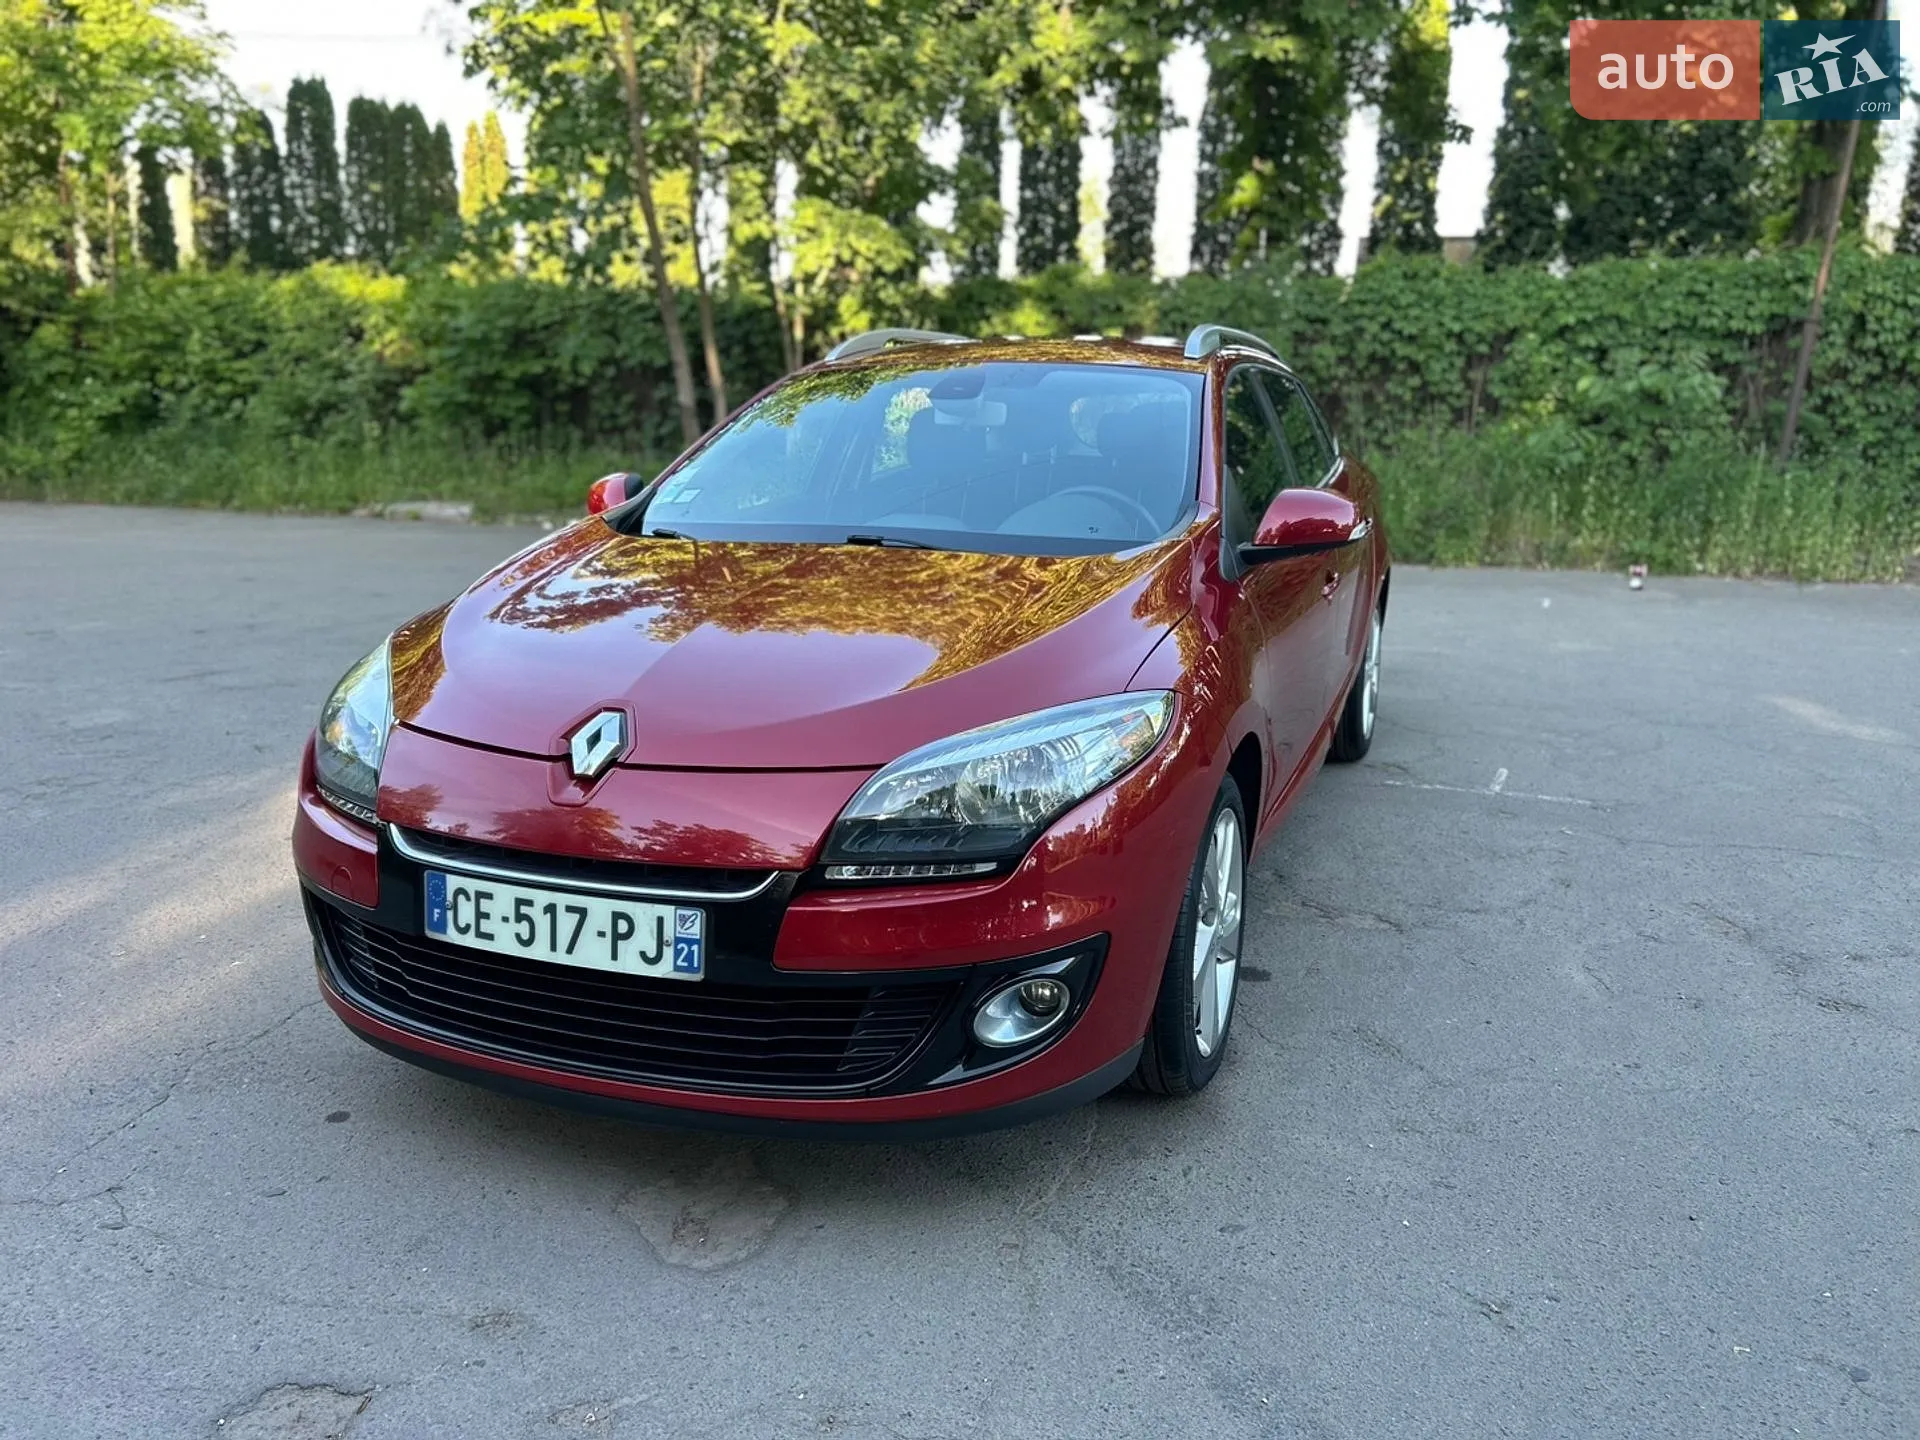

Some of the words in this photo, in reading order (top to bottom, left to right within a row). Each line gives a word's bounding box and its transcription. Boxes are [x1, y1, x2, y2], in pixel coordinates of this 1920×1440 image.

[433, 908, 441, 922] F
[452, 886, 665, 966] CE-517-PJ
[676, 942, 699, 968] 21
